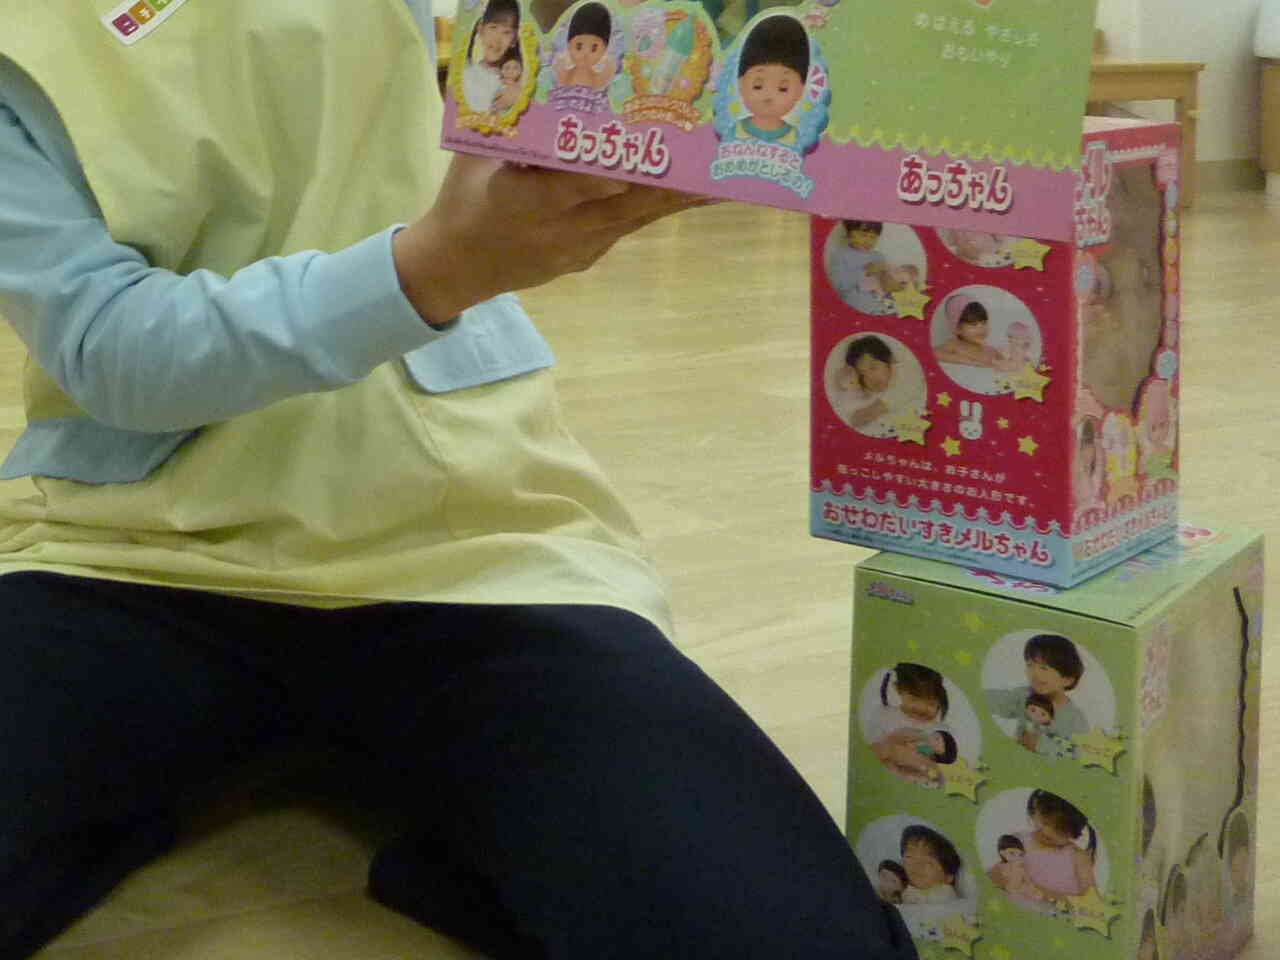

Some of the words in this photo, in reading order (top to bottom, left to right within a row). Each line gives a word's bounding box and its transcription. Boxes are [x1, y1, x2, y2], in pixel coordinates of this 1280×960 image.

[556, 115, 668, 174] あっちゃん
[897, 155, 1012, 212] あっちゃん
[822, 499, 1053, 566] おせわだいすきメルちゃん
